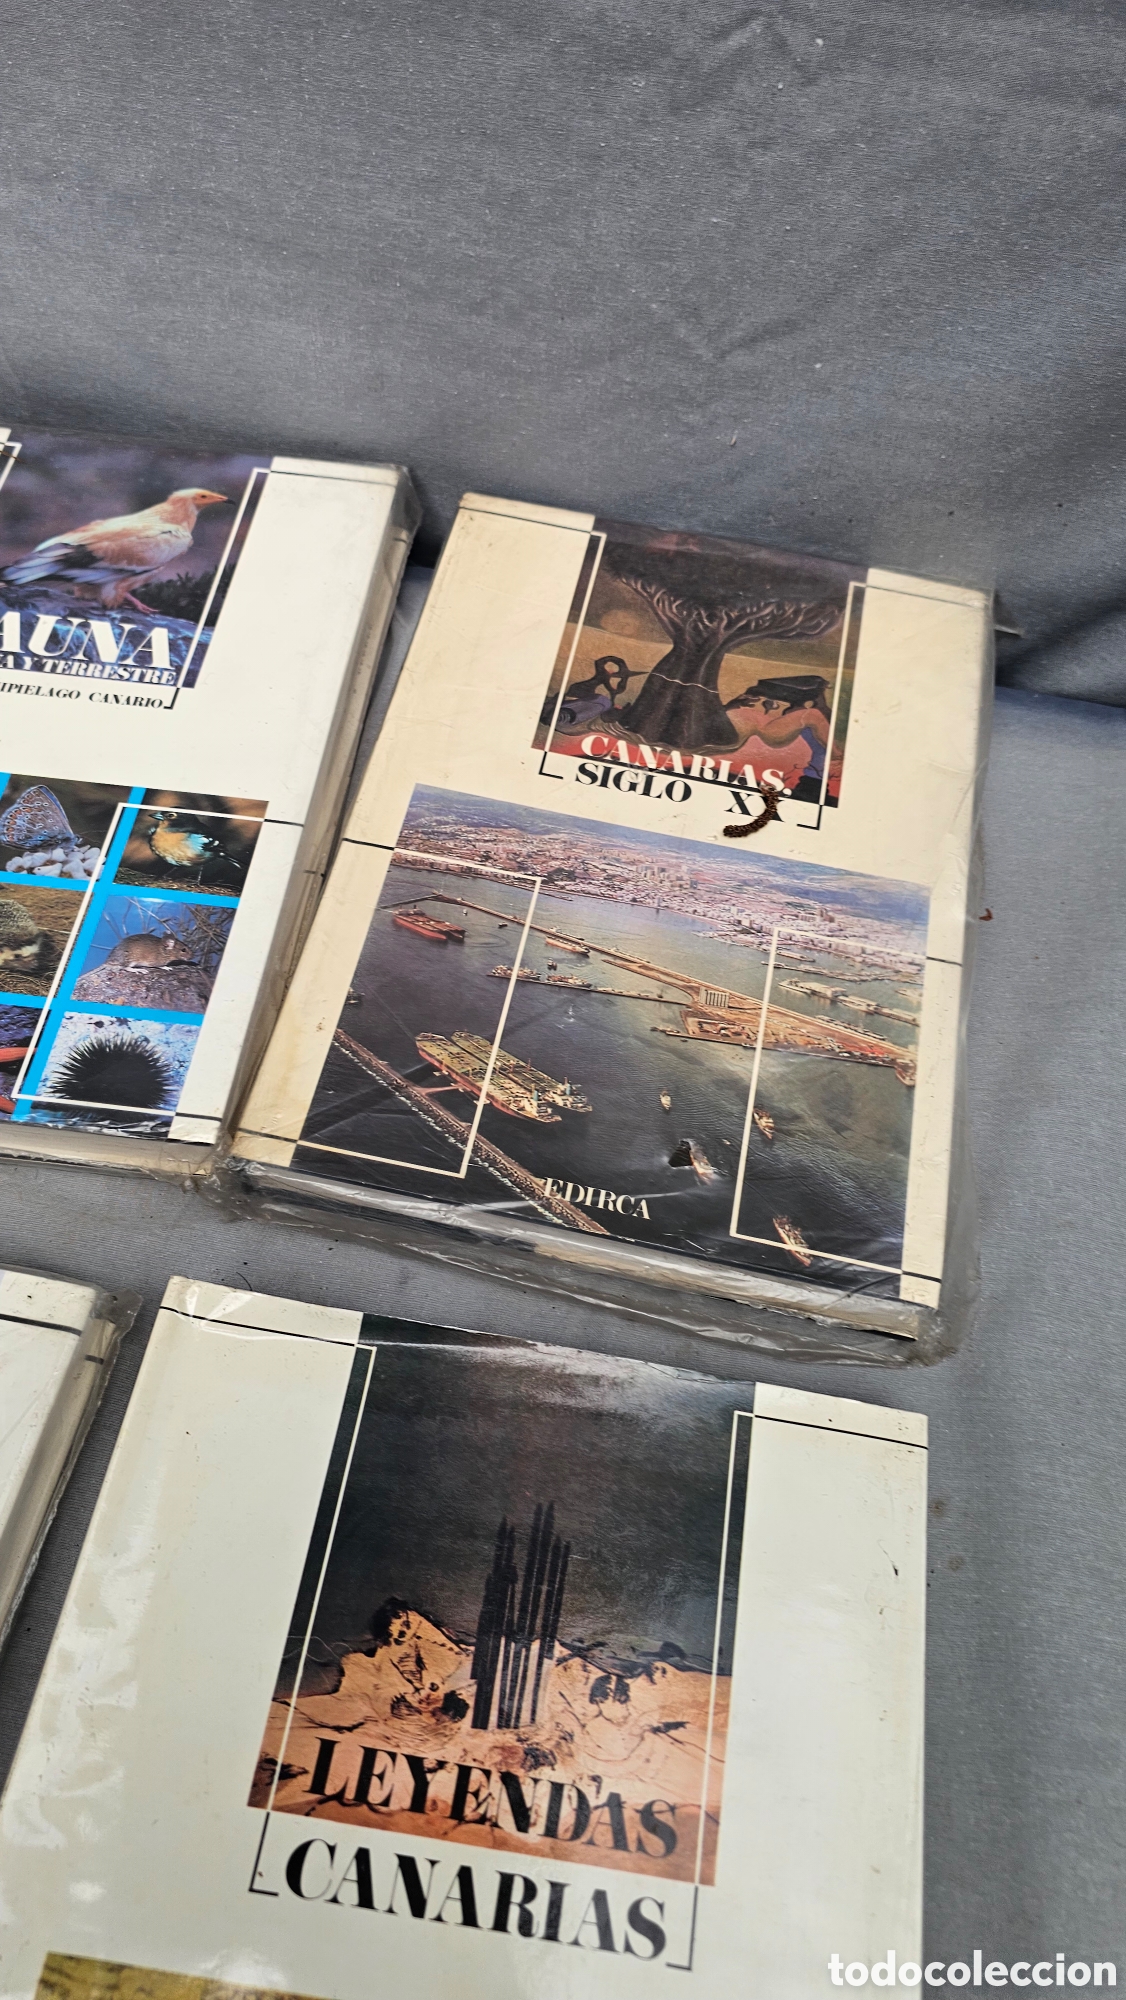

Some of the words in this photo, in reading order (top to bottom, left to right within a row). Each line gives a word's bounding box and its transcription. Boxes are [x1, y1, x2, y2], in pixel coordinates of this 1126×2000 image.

[0, 611, 176, 670] AUNA
[22, 656, 40, 671] Y
[42, 658, 177, 686] TERRESTRE
[0, 682, 81, 700] IPIELAGO
[89, 691, 164, 709] CANARIO
[575, 762, 692, 803] SIGLO
[544, 1176, 651, 1220] EDIRCA
[303, 1736, 678, 1858] LEYENDAS
[285, 1838, 667, 1961] CANARIAS
